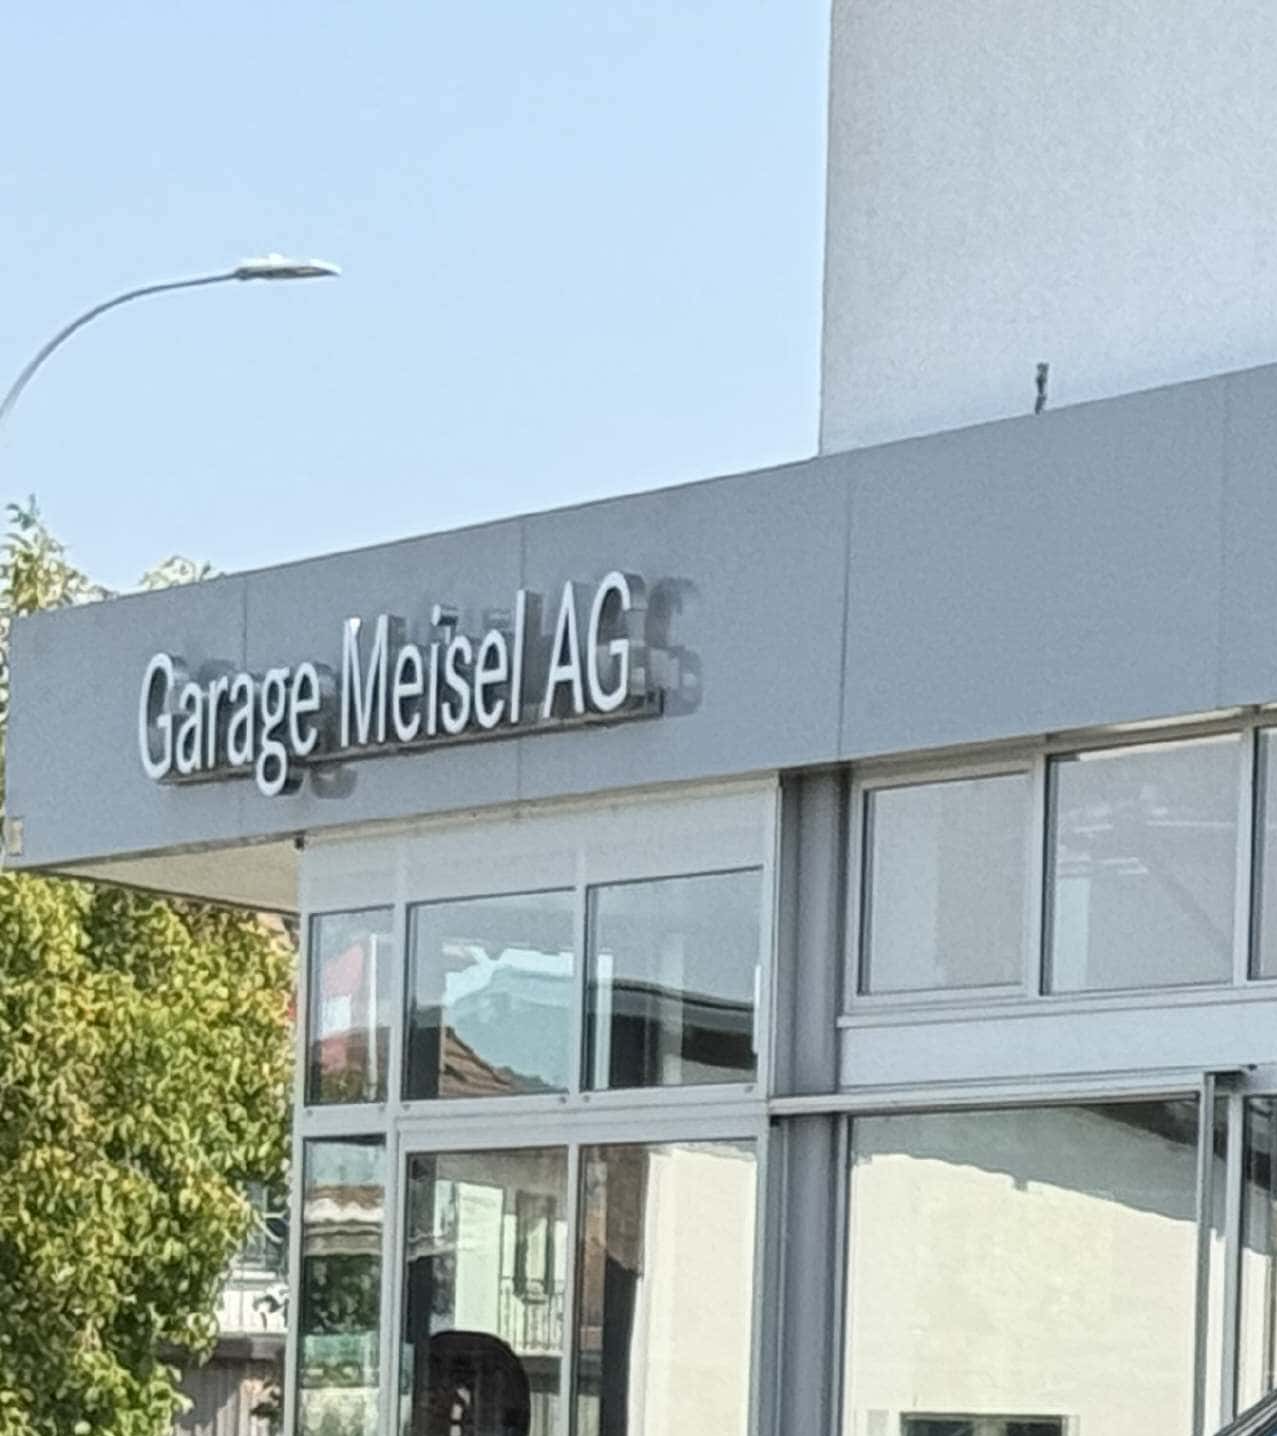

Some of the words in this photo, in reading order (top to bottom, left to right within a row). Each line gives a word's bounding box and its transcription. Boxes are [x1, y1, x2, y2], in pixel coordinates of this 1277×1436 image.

[138, 652, 321, 796] Garage
[340, 588, 526, 748] Meisel
[543, 569, 635, 720] AG
